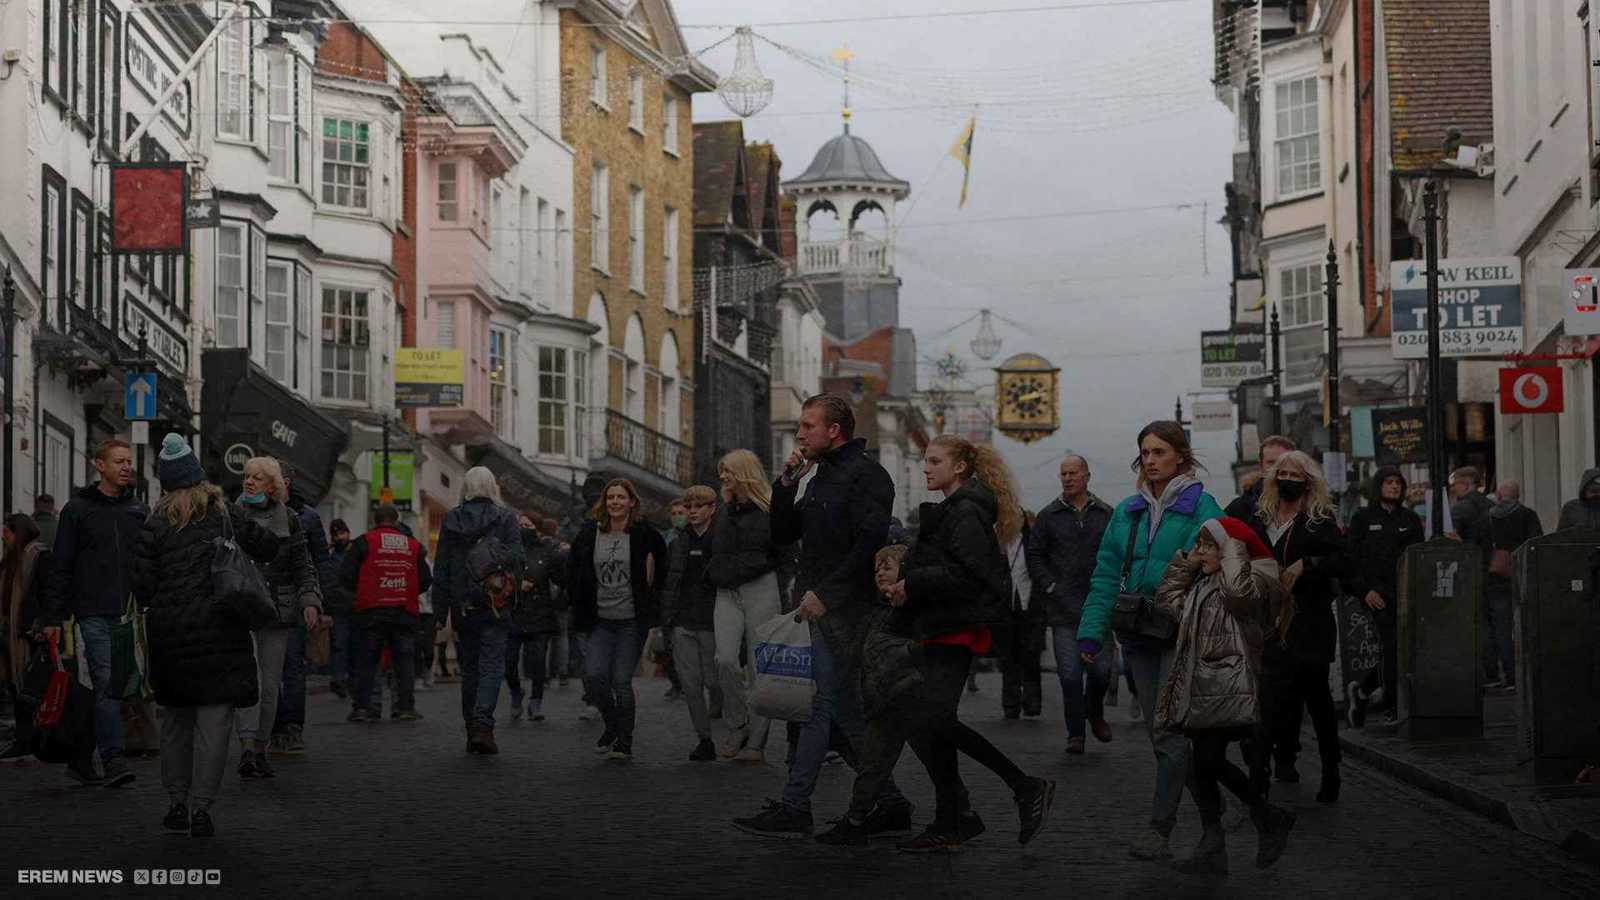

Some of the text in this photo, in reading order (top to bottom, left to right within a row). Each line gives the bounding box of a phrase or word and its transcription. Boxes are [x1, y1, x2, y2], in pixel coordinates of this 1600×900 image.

[1439, 265, 1514, 282] W KEIL
[1436, 289, 1481, 304] SHOP
[1456, 304, 1502, 327] LET
[1397, 333, 1429, 346] 020
[1475, 330, 1518, 345] 9024
